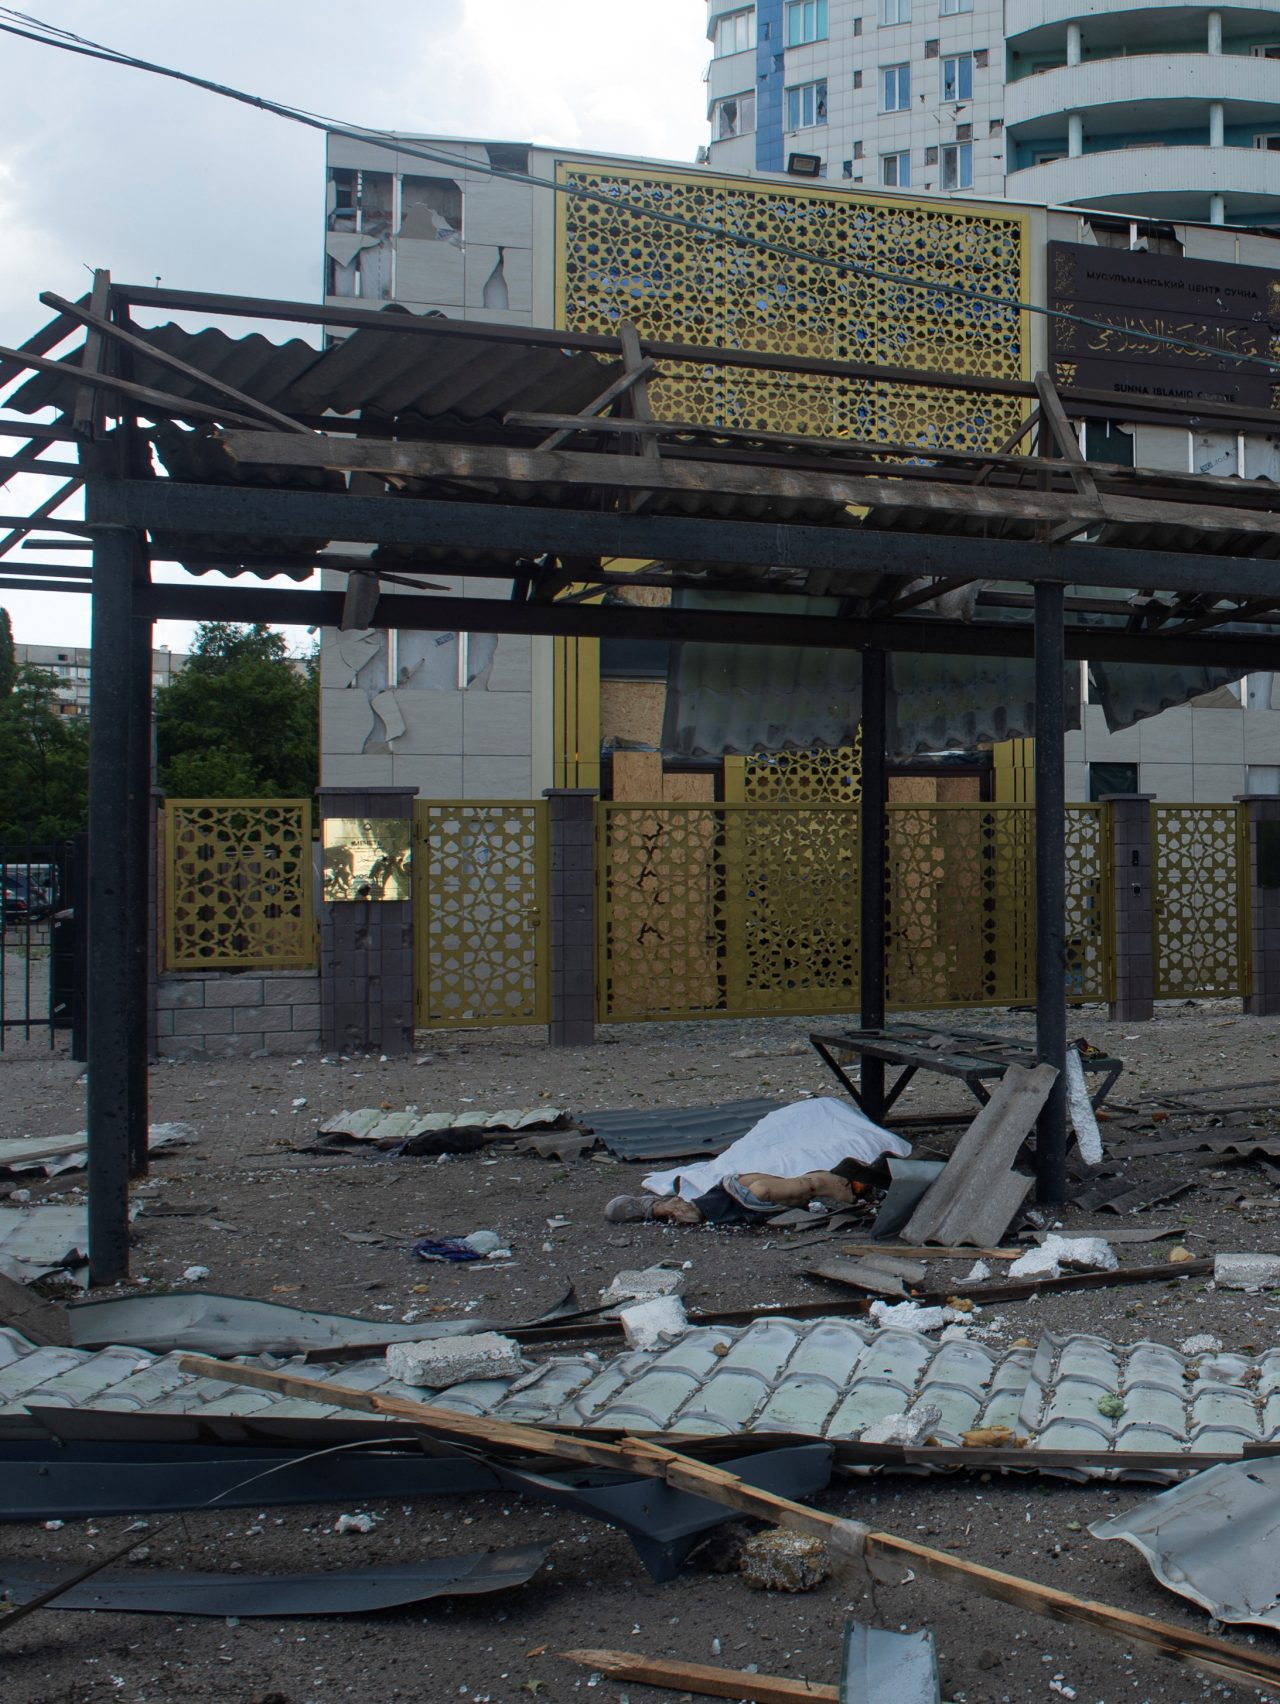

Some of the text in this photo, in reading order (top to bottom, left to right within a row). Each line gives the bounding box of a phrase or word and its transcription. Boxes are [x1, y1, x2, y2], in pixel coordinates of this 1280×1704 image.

[1188, 283, 1221, 296] ЦЕНТР
[1113, 383, 1149, 396] SUNNA
[1152, 387, 1193, 401] ISLAMIC
